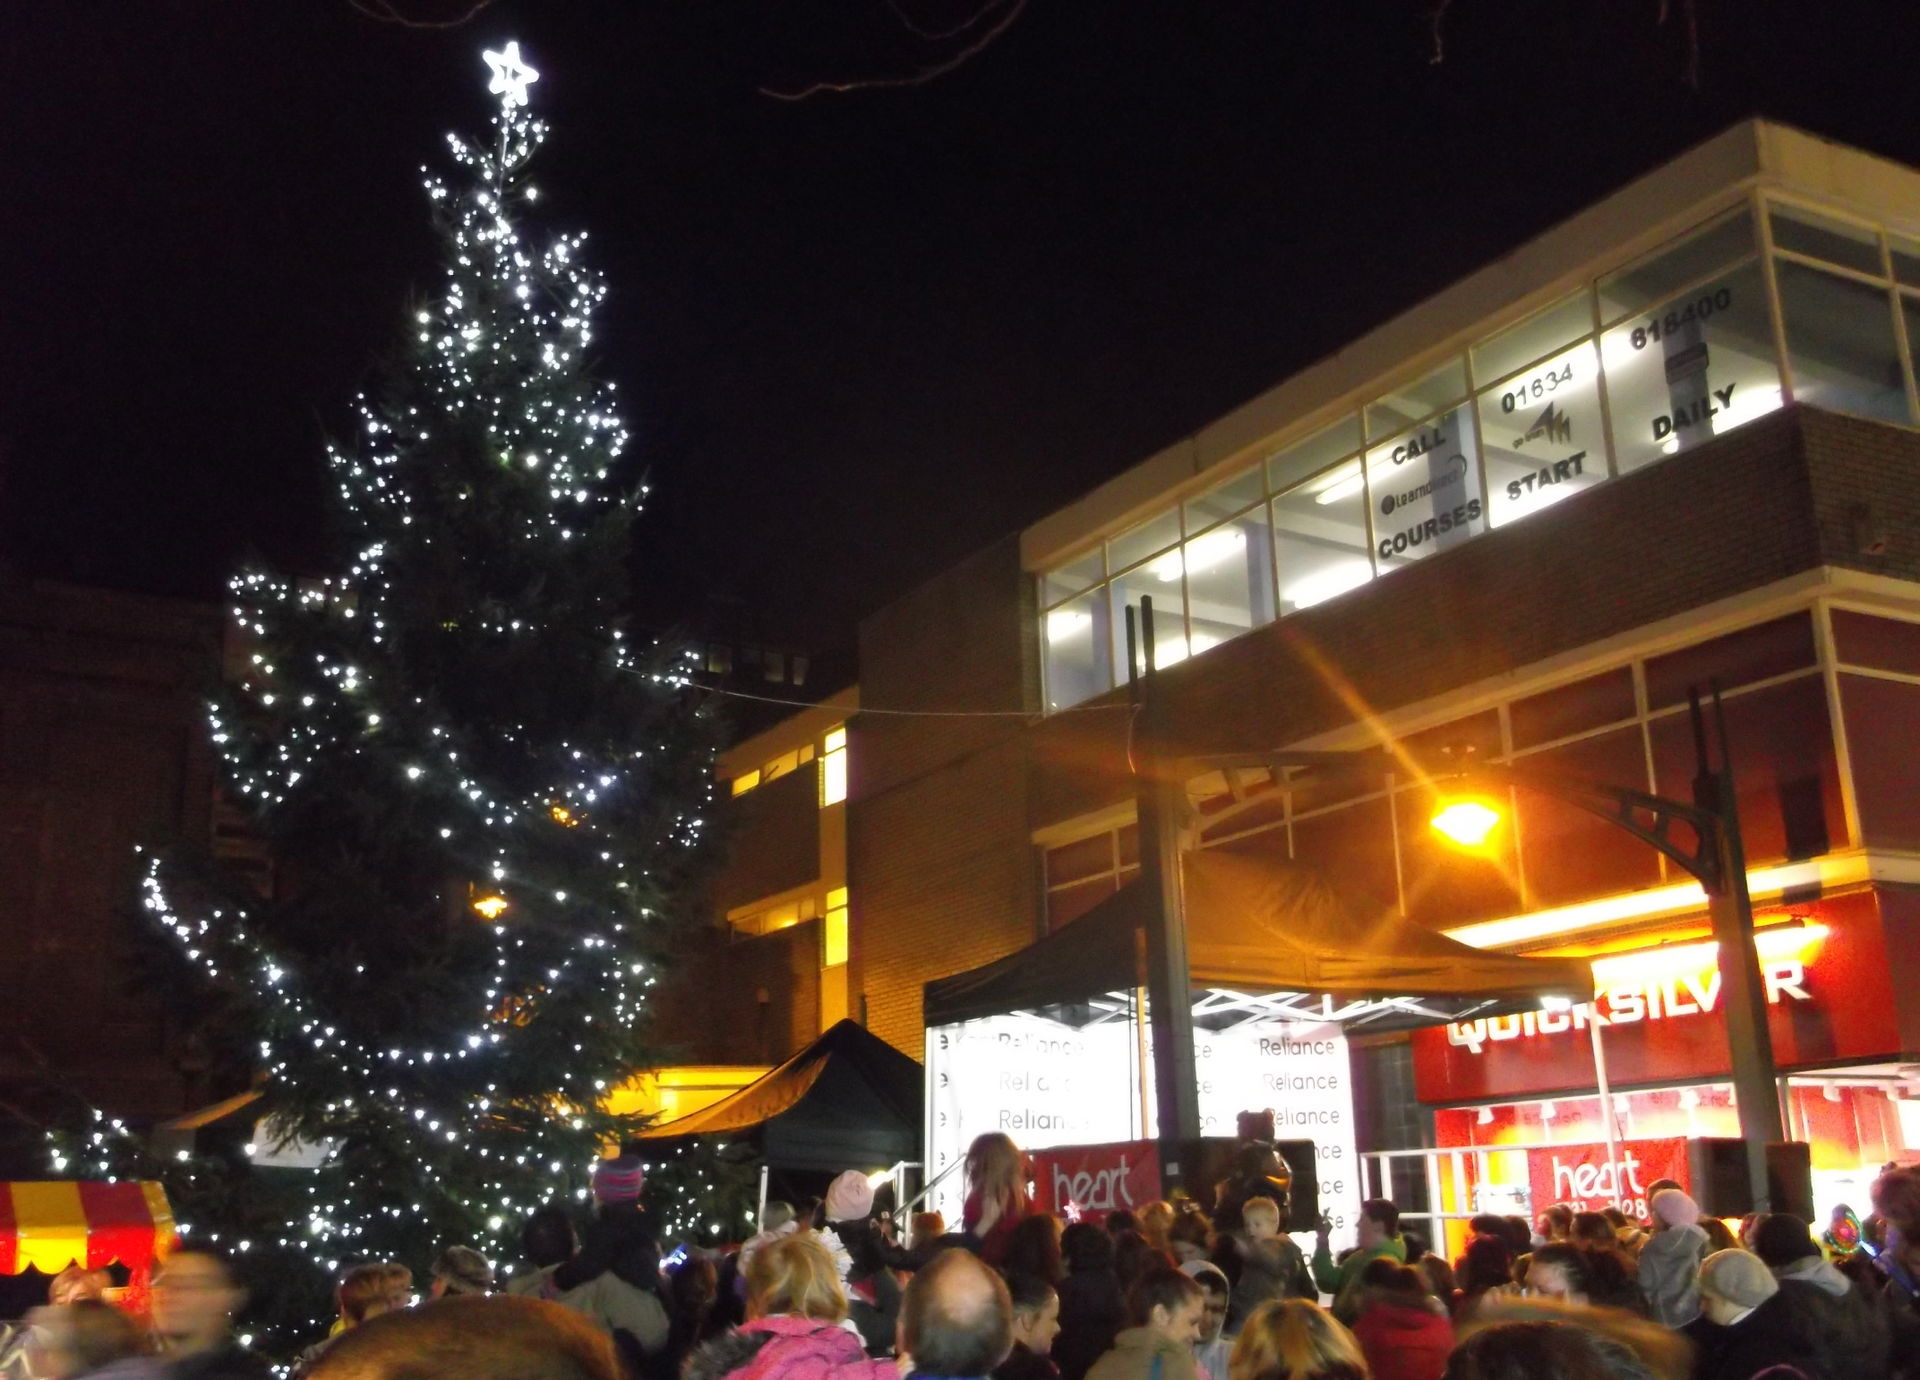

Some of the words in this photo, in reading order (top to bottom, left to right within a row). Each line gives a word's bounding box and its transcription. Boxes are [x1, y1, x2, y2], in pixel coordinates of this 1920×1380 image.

[1392, 428, 1446, 465] CALL
[1501, 363, 1573, 414] 01634
[1379, 499, 1481, 559] COURSES
[1507, 450, 1586, 500] START
[1652, 383, 1736, 441] DAILY
[1447, 960, 1812, 1054] QUICKSILVR
[1259, 1037, 1335, 1056] Reliance
[1263, 1071, 1338, 1091] Reliance
[999, 1108, 1080, 1130] Relian
[1053, 1153, 1133, 1213] heart
[1552, 1150, 1645, 1199] heart
